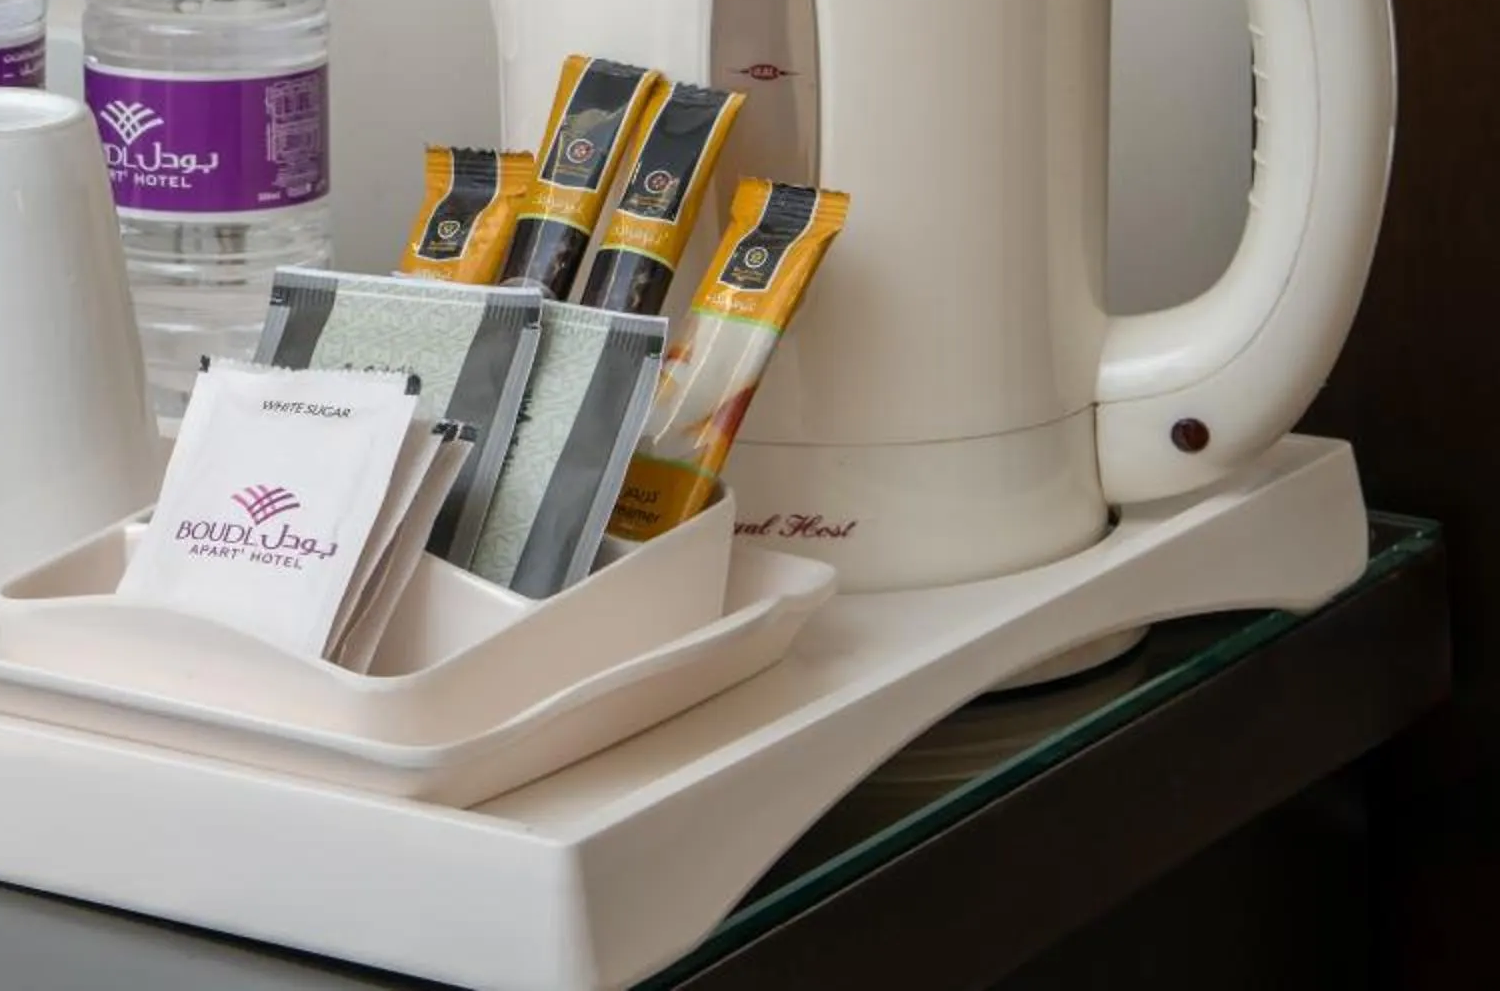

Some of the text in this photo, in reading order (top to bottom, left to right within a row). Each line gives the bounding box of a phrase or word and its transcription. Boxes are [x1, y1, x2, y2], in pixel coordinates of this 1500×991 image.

[134, 172, 192, 188] HOTEL
[262, 400, 351, 418] WHITE SUGAR
[175, 520, 257, 546] BOUDL
[779, 513, 856, 538] Host
[250, 552, 303, 569] HOTEL
